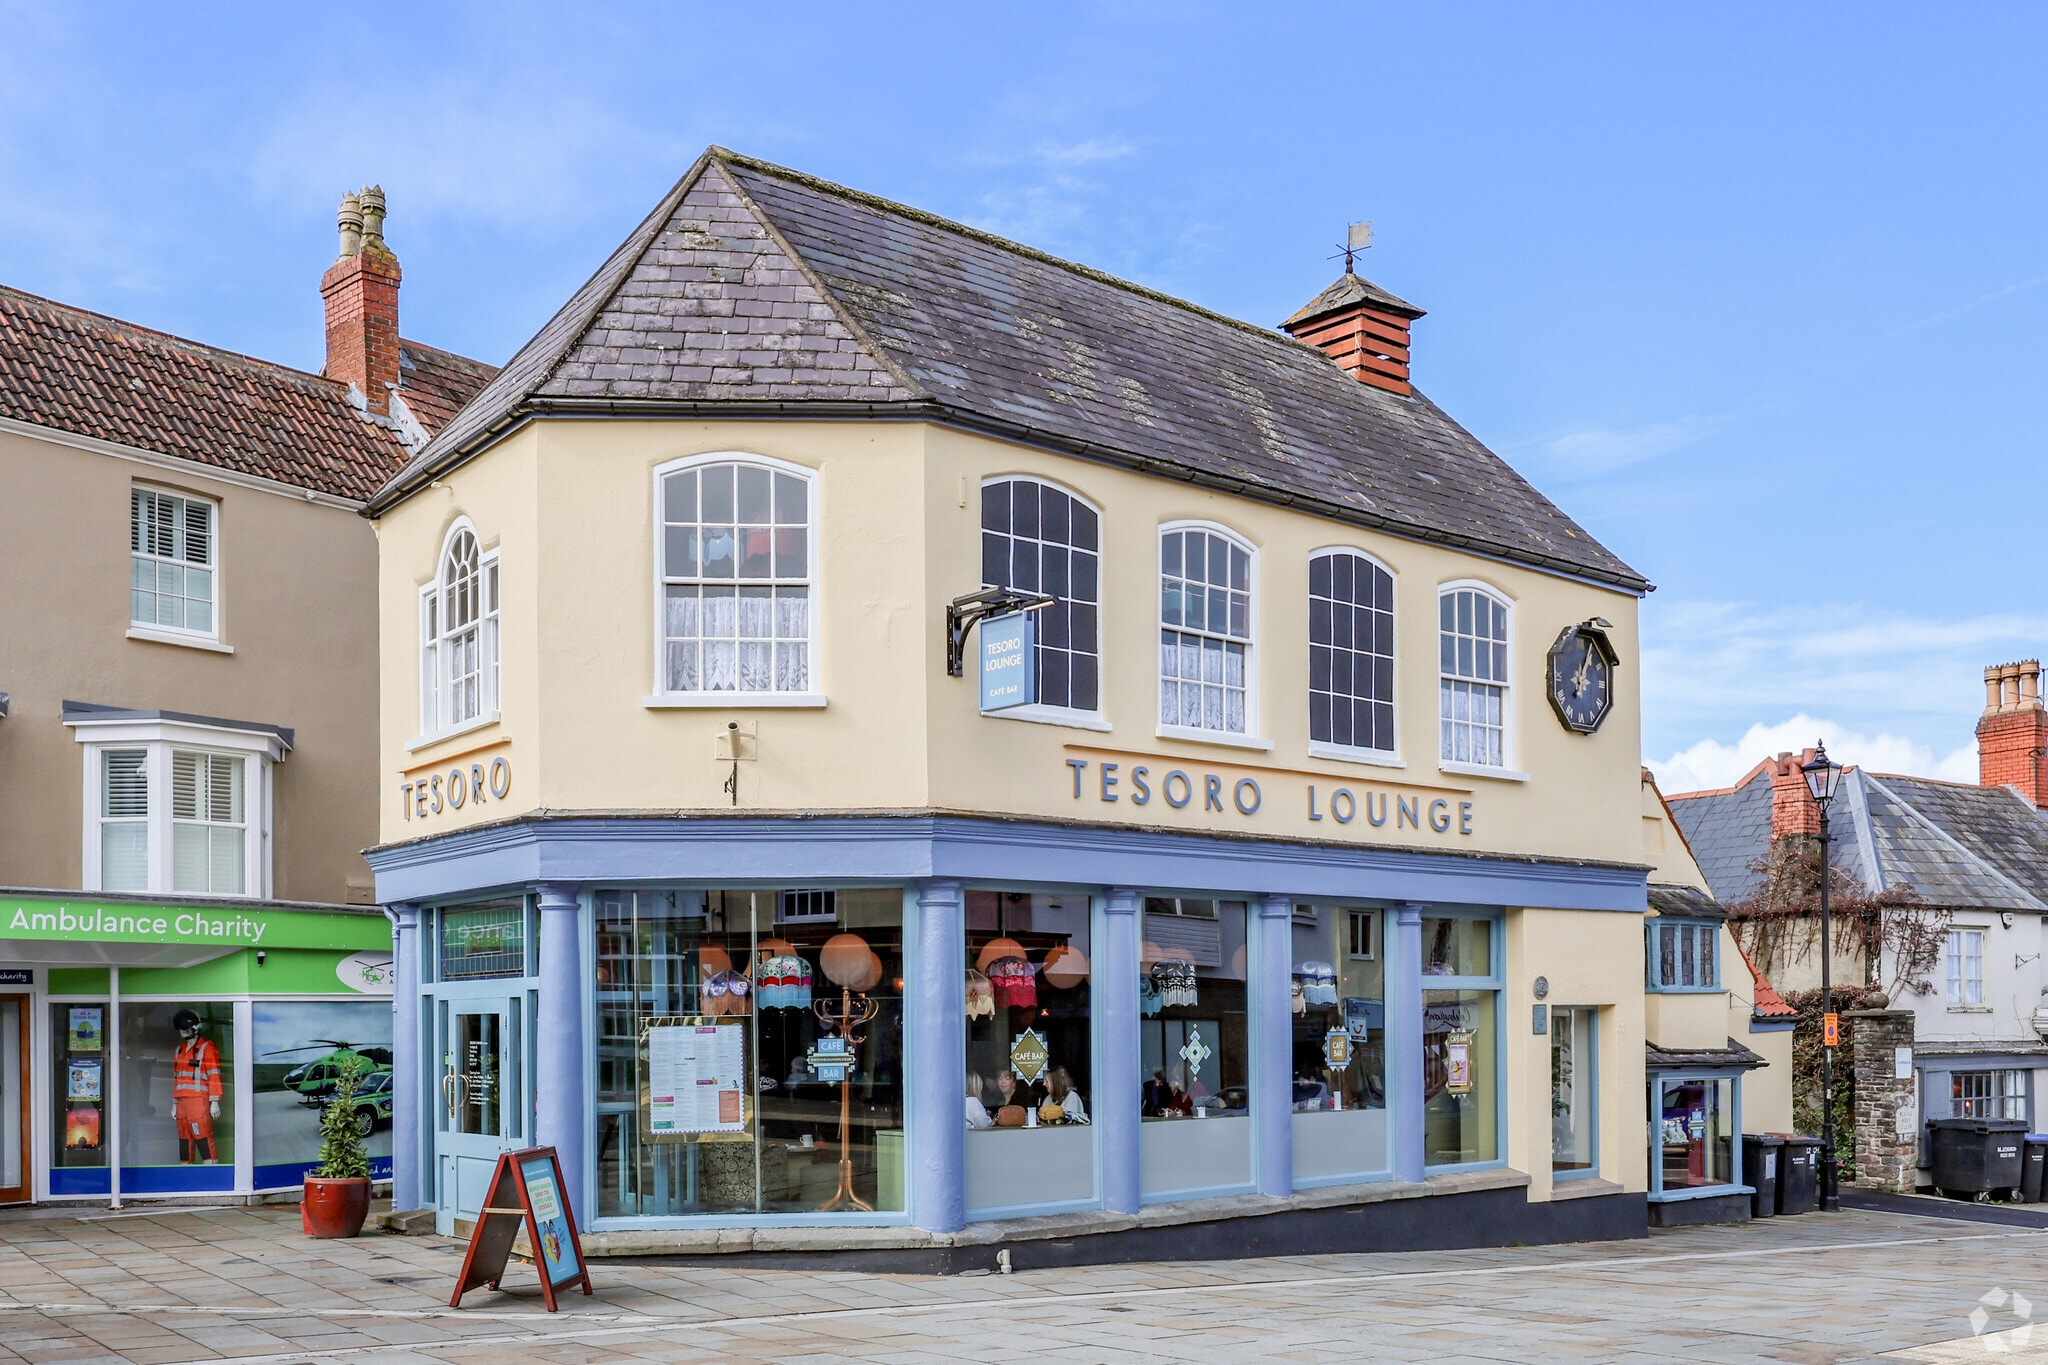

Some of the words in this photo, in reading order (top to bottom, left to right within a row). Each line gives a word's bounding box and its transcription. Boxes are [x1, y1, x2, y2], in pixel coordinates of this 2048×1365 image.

[986, 638, 1021, 656] TESORO
[985, 653, 1022, 672] LOUNGE
[1006, 684, 1018, 695] BAR
[400, 756, 512, 822] TESORO
[1066, 758, 1262, 815] TESORO
[1307, 785, 1473, 834] LOUNGE
[9, 906, 168, 934] Ambulance
[174, 912, 267, 942] Charity
[820, 1040, 842, 1051] CAFÉ
[1332, 1040, 1345, 1049] CAFÉ
[1014, 1051, 1031, 1061] CAFÉ
[1031, 1052, 1045, 1060] BAR
[1333, 1049, 1343, 1057] BAR
[823, 1068, 839, 1078] BAR
